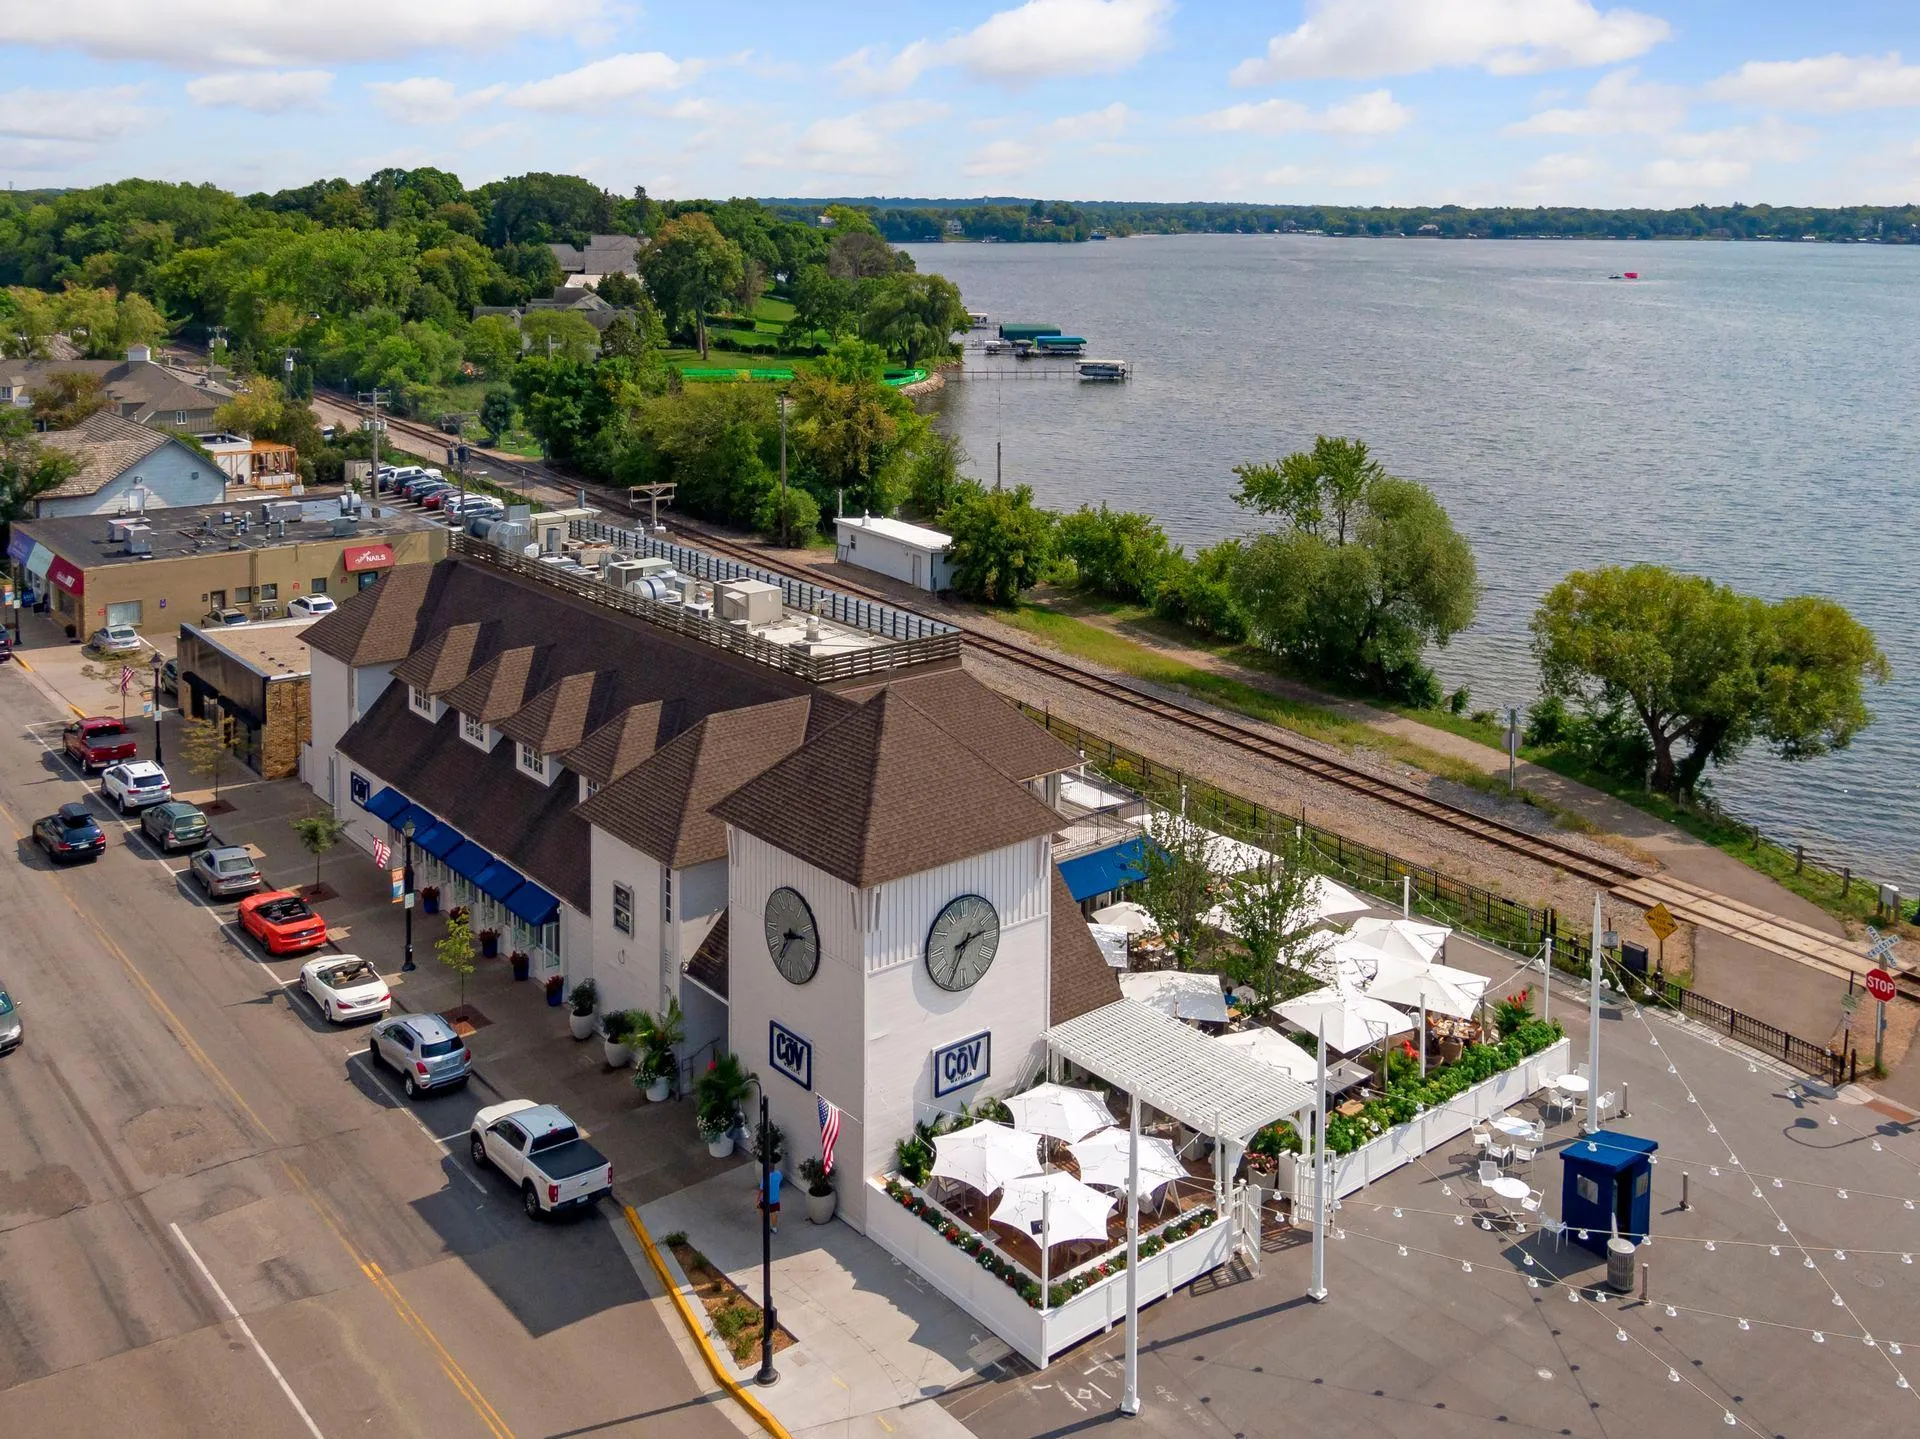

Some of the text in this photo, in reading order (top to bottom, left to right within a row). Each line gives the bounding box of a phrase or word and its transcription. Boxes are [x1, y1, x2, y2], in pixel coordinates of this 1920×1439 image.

[366, 554, 386, 562] NAILS
[1867, 936, 1898, 957] CROSSING
[1867, 976, 1894, 994] STOP
